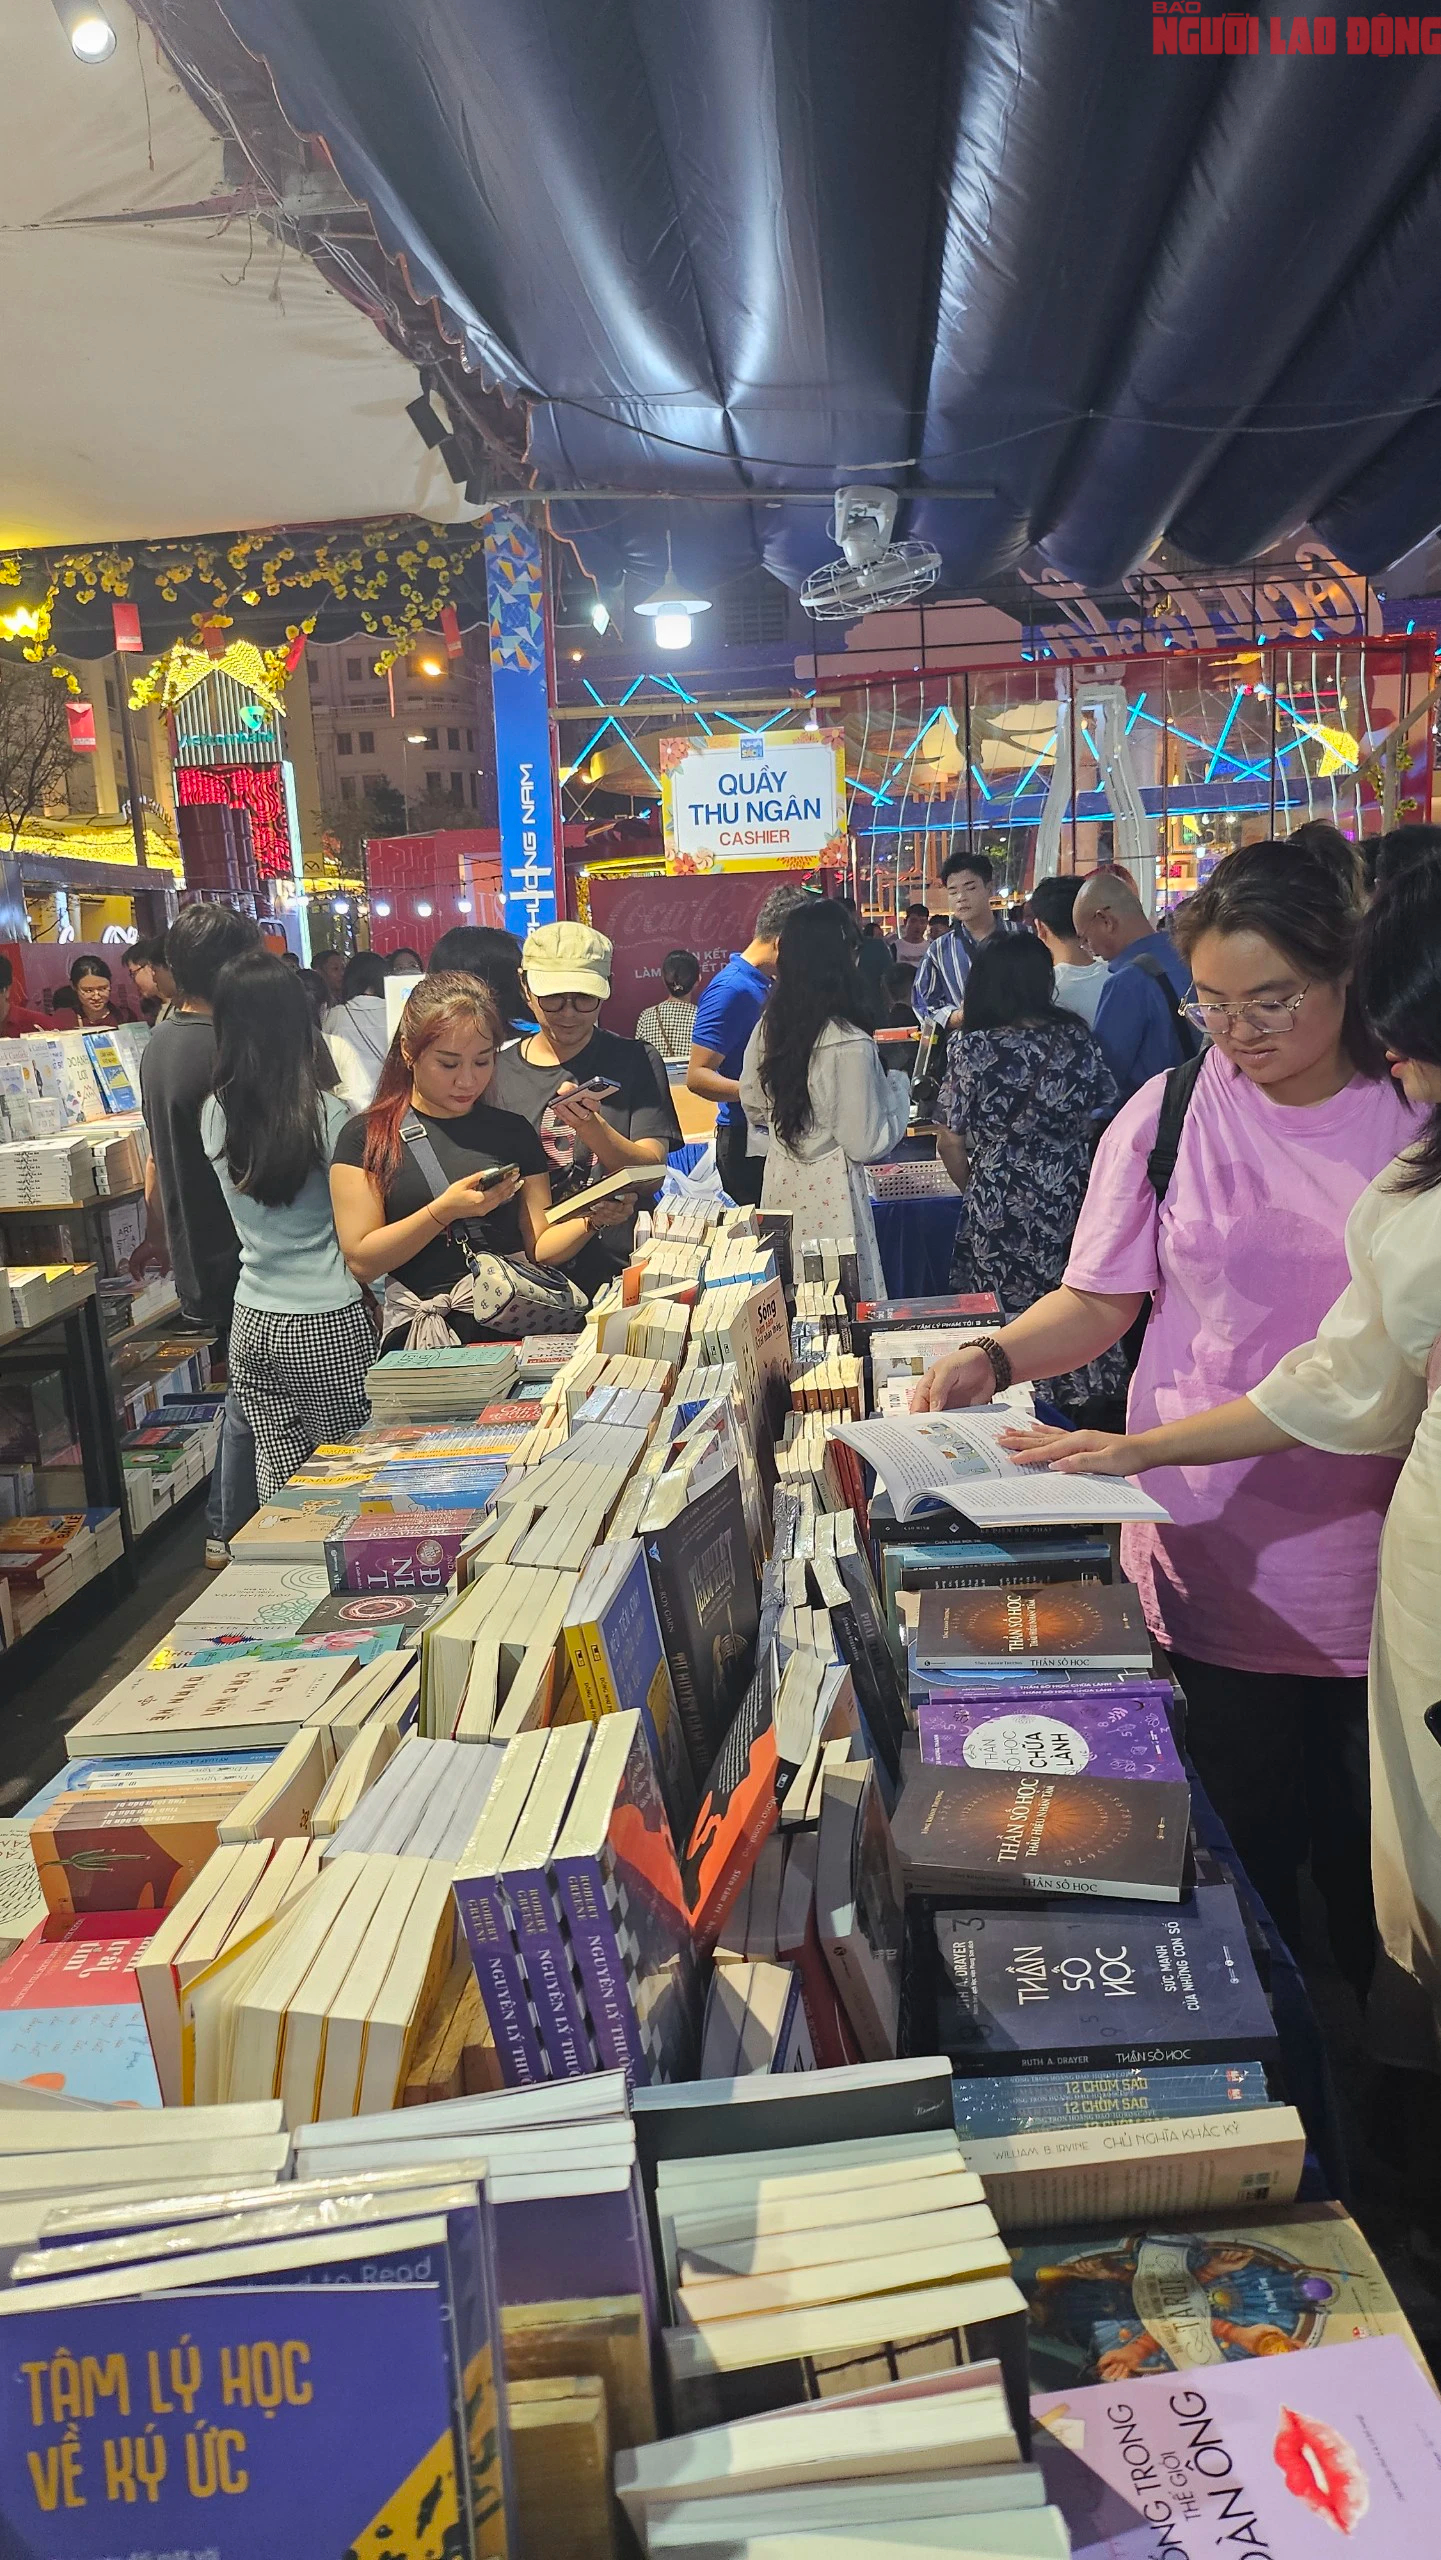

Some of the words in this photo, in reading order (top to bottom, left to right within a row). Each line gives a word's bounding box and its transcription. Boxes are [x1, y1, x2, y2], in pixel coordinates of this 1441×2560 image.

[519, 763, 536, 825] NAM
[718, 764, 787, 796] QUẦY
[688, 801, 739, 825] THU
[747, 794, 821, 823] NGÂN
[719, 829, 790, 846] CASHIER
[635, 967, 661, 979] LÀM
[757, 1299, 777, 1324] Sống
[1007, 1595, 1026, 1617] HỌC
[1030, 1657, 1055, 1667] THẦN
[1070, 1658, 1090, 1667] HỌC
[979, 1739, 998, 1766] THẦN
[1002, 1730, 1020, 1756] HỌC
[1022, 1731, 1048, 1769] CHỮA
[1050, 1732, 1074, 1767] LÀNH
[1017, 1777, 1041, 1806] HỌC
[1004, 1805, 1031, 1823] SỐ
[996, 1823, 1024, 1863] THẦN
[567, 1876, 587, 1922] GREENE
[579, 1874, 600, 1921] ROBERT
[1022, 1877, 1053, 1889] THẦN
[1056, 1877, 1071, 1891] SỐ
[1072, 1881, 1098, 1893] HỌC
[467, 1899, 487, 1945] GREENE
[479, 1897, 500, 1943] ROBERT
[517, 1890, 536, 1936] GREENE
[528, 1888, 548, 1934] ROBERT
[1161, 1921, 1181, 1935] SỐ
[952, 1941, 968, 1977] DRAYER
[1155, 1945, 1172, 1973] MẠNH
[1171, 1937, 1186, 1957] CON
[588, 1935, 615, 1999] NGUYÊN
[605, 2002, 625, 2020] LÝ
[1005, 1946, 1050, 2006] THẦN
[1051, 1957, 1096, 1991] SỐ
[1096, 1946, 1137, 1997] HỌC
[1160, 1974, 1177, 1993] SỨC
[1176, 1960, 1195, 1992] NHỮNG
[489, 1957, 517, 2017] NGUYÊN
[506, 2024, 526, 2042] LÝ
[538, 1949, 566, 2013] NGUYÊN
[555, 2017, 574, 2034] LÝ
[1182, 1994, 1200, 2011] CỦA
[1021, 2057, 1044, 2067] RUTH
[1057, 2054, 1089, 2065] DRAYER
[1115, 2052, 1146, 2064] THẦN
[1165, 2048, 1191, 2061] HỌC
[1065, 2081, 1080, 2094] 12
[1122, 2077, 1149, 2090] SAO
[1064, 2101, 1080, 2114] 12
[1122, 2097, 1149, 2110] SAO
[993, 2147, 1039, 2160] WILLIAM
[1055, 2141, 1089, 2154] IRVINE
[1103, 2133, 1134, 2150] CHỦ
[1136, 2127, 1179, 2147] NGHĨA
[1183, 2125, 1221, 2141] KHẮC
[1222, 2120, 1242, 2136] KỶ
[361, 2255, 432, 2284] Read
[1158, 2277, 1201, 2336] TAROT
[20, 2346, 132, 2427] TÂM
[148, 2333, 203, 2415] LÝ
[221, 2340, 314, 2419] HỌC
[1107, 2403, 1161, 2496] TRONG
[1169, 2390, 1233, 2479] ÔNG
[27, 2423, 87, 2513] VỀ
[104, 2422, 168, 2503] KÝ
[185, 2418, 250, 2499] ỨC
[1160, 2451, 1189, 2488] GIỚI
[1173, 2490, 1201, 2522] THẾ
[1144, 2499, 1190, 2560] ỐNG
